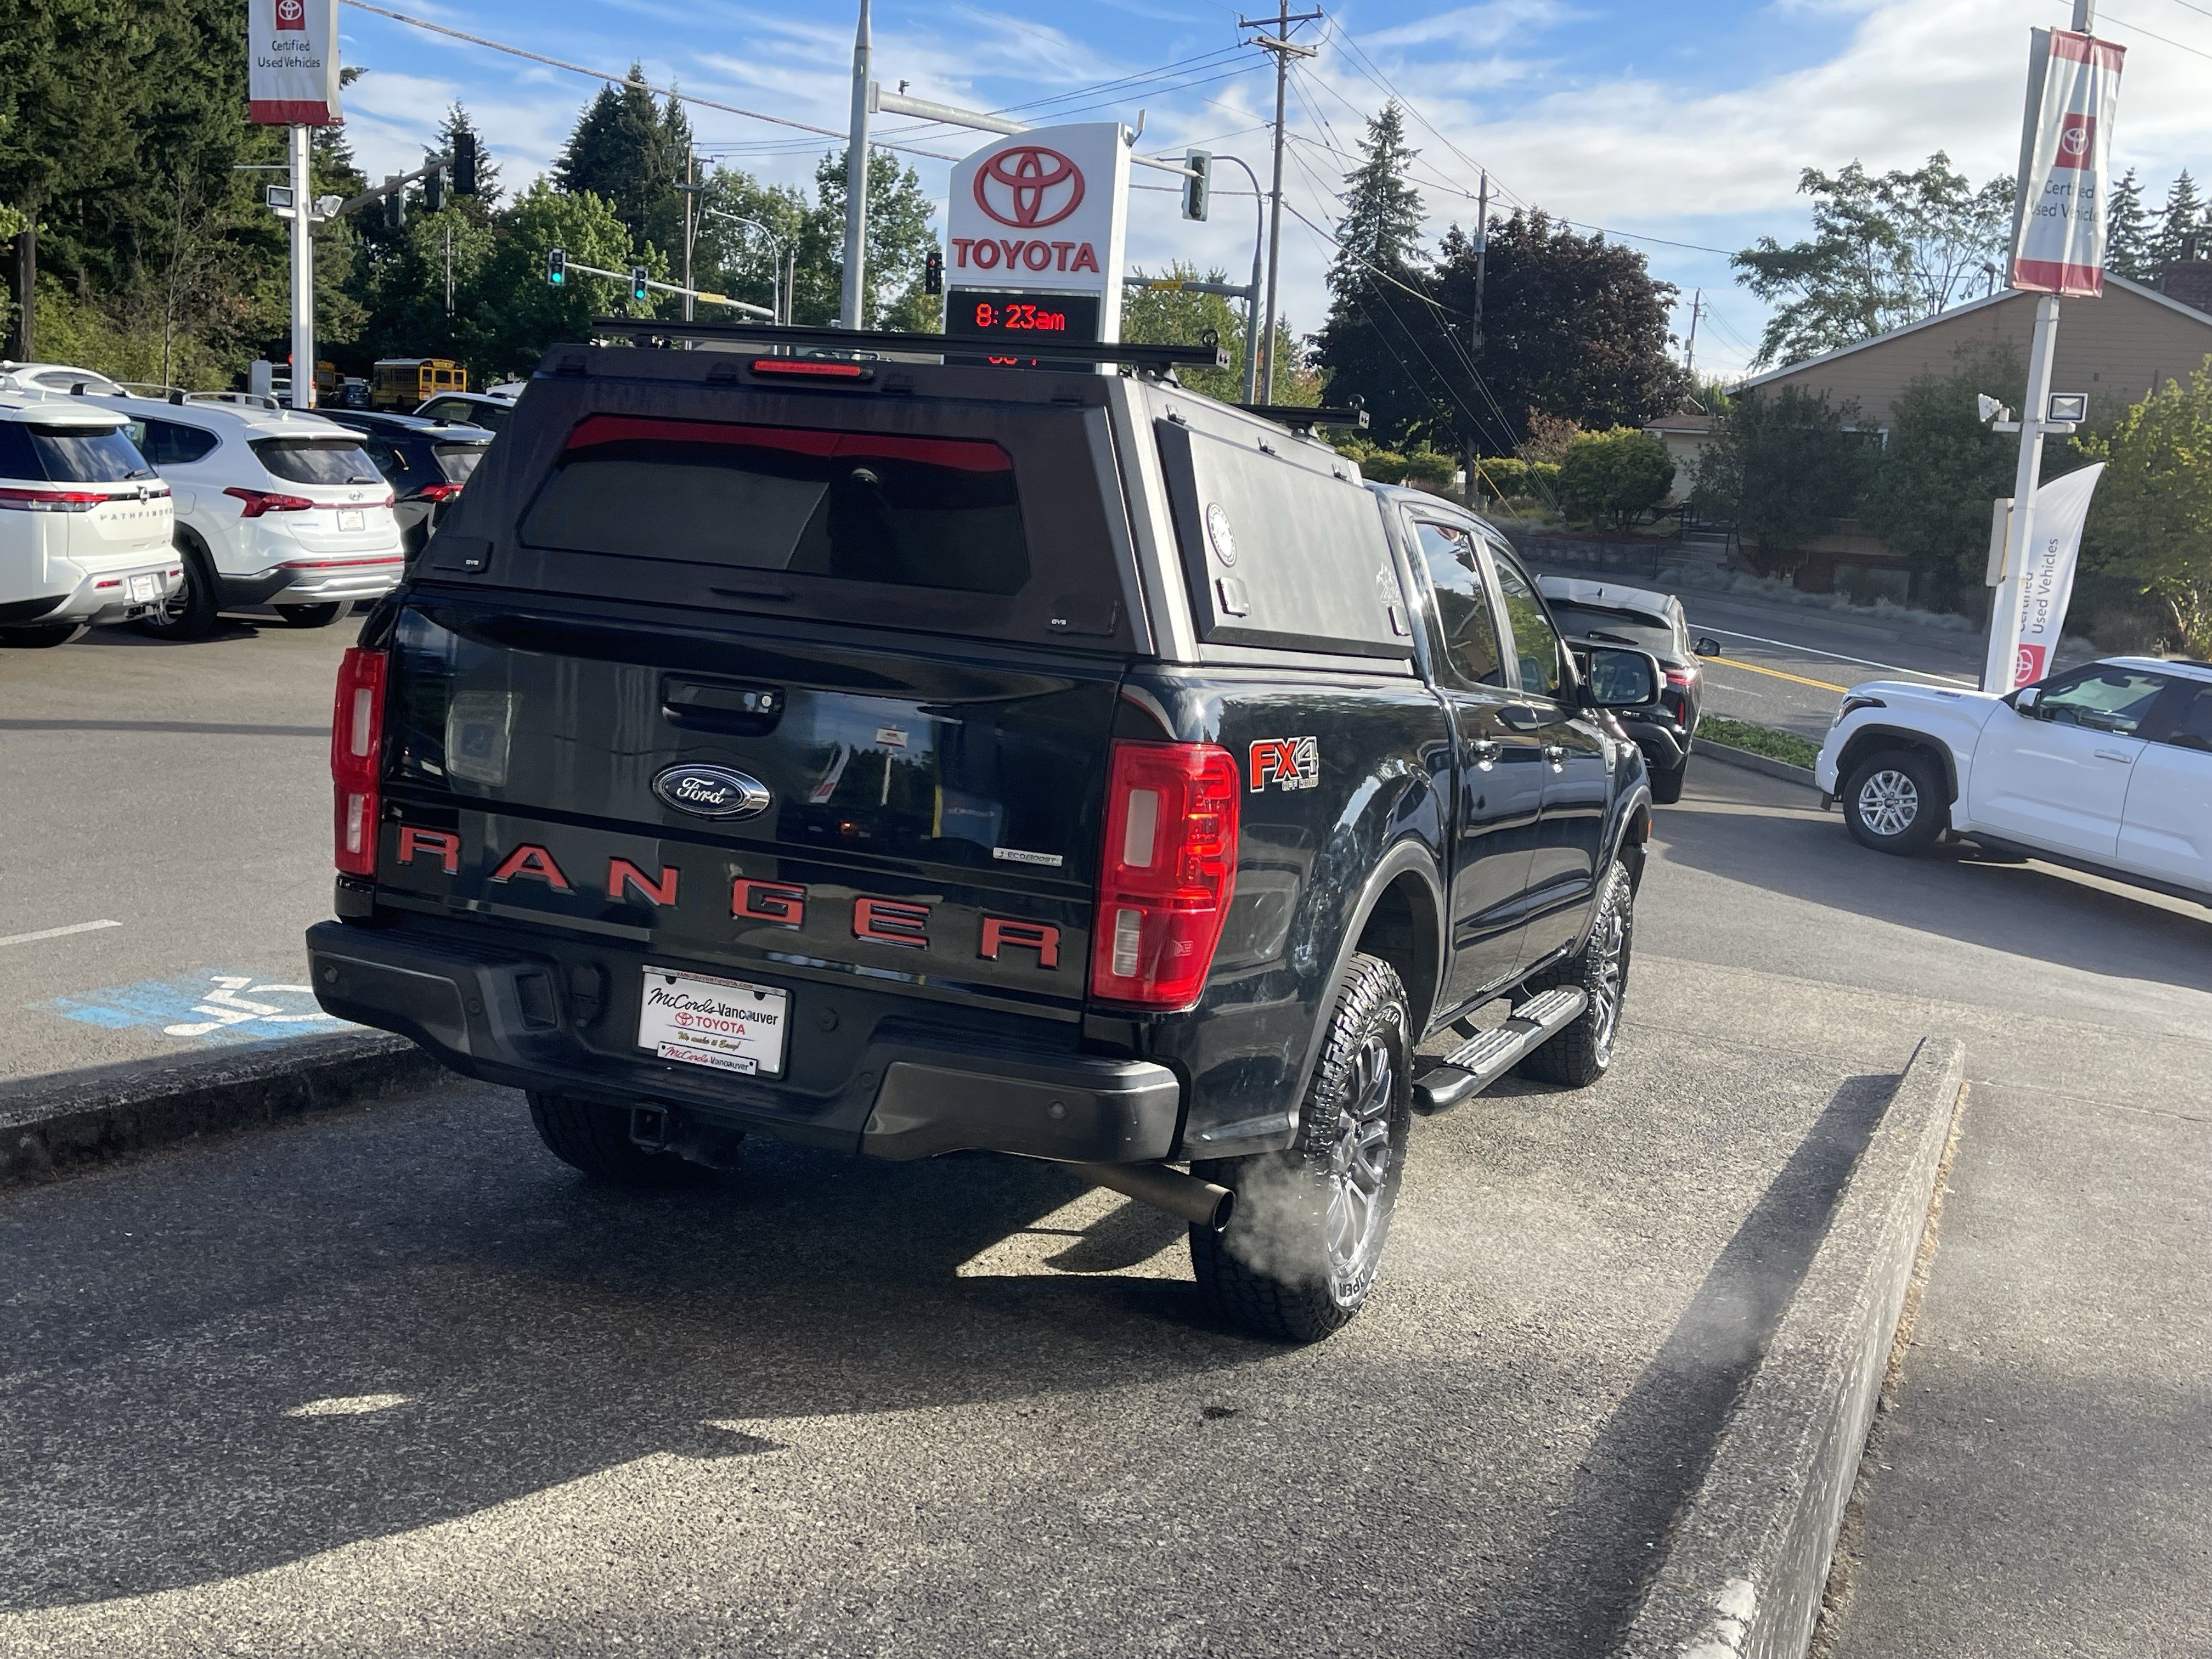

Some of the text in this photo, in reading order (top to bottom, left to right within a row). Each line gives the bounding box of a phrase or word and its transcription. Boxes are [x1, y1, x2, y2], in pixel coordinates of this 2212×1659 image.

[272, 40, 310, 52] Certified
[258, 56, 320, 68] Used Vehicles
[952, 238, 1099, 273] TOYOTA
[975, 303, 1065, 331] 8:23am
[2032, 538, 2058, 634] Used Vehicles
[1249, 736, 1319, 793] FX4
[676, 777, 725, 804] Ford
[1008, 851, 1056, 863] ECOBOOST
[398, 826, 1060, 970] RANGER
[696, 1015, 746, 1035] TOYOTA
[718, 1002, 778, 1025] Vancouver
[710, 1056, 749, 1070] Vancouver
